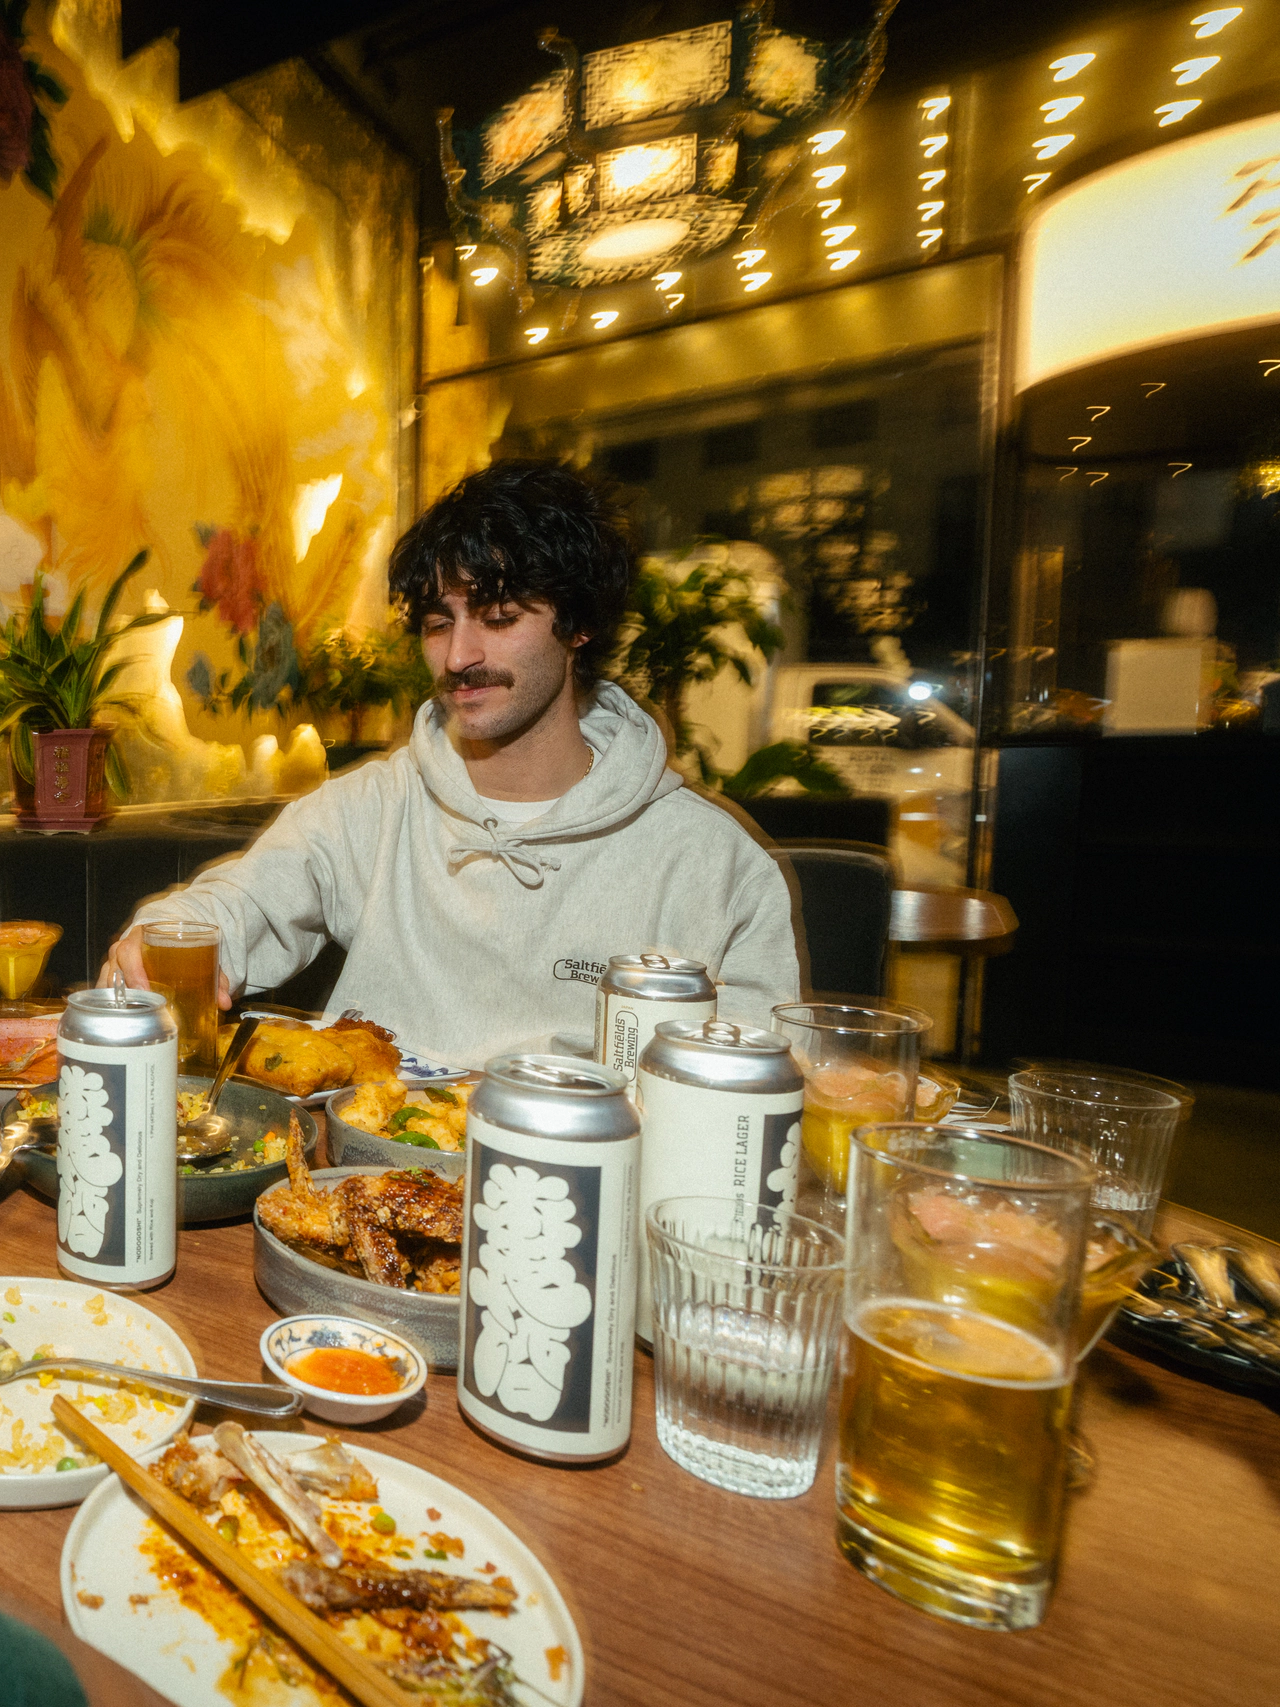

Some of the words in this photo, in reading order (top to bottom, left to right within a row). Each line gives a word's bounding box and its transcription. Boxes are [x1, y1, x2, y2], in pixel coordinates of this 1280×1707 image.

[570, 969, 600, 983] Brew
[624, 1027, 638, 1068] Brewing
[736, 1115, 749, 1155] LAGER
[733, 1159, 747, 1187] RICE
